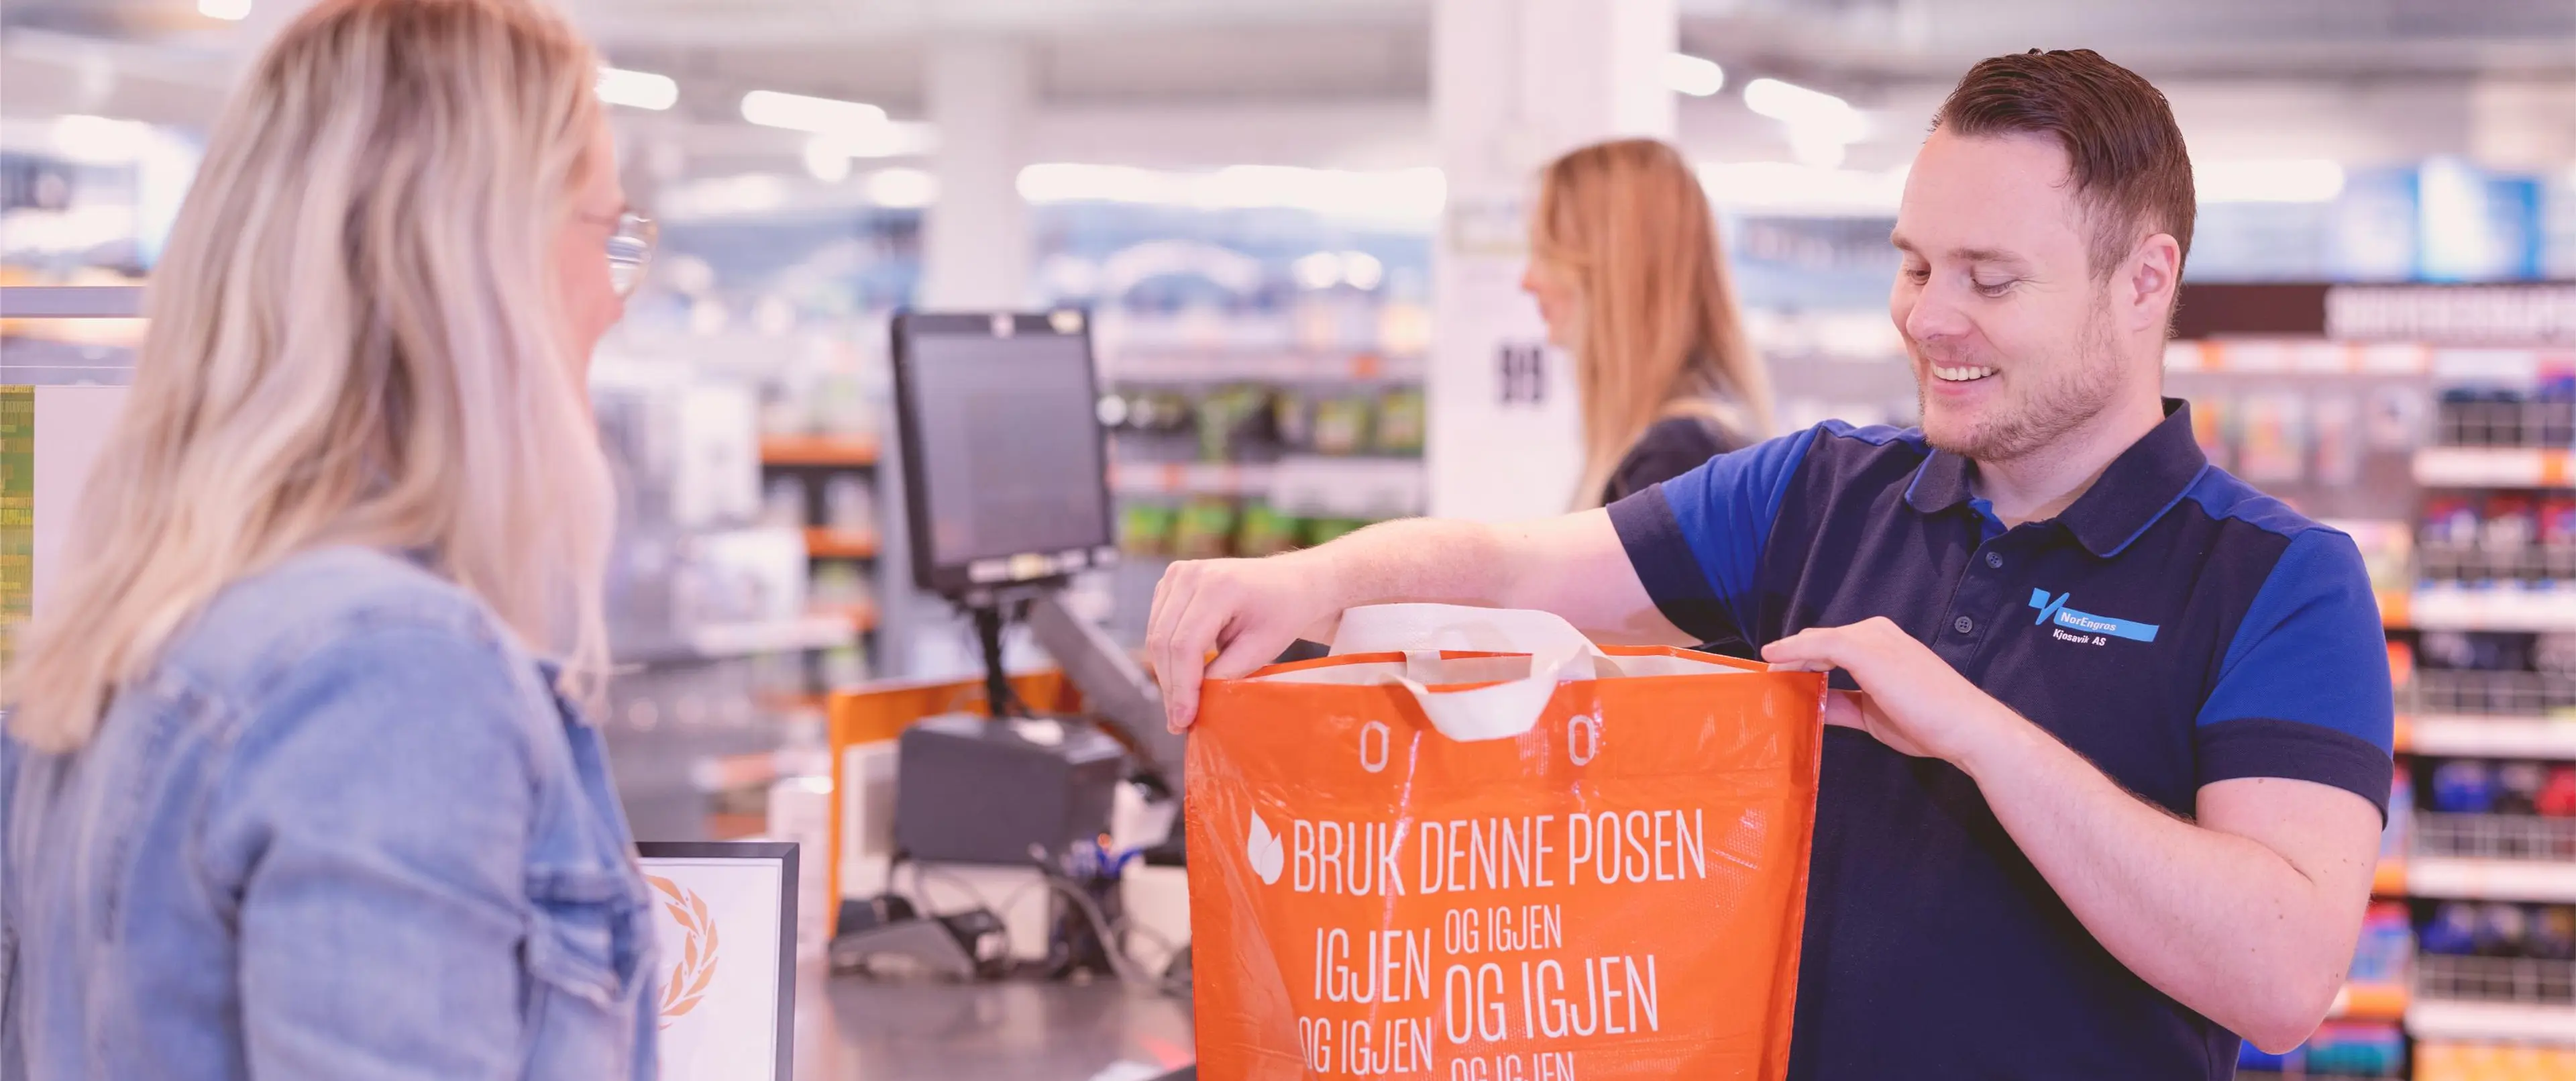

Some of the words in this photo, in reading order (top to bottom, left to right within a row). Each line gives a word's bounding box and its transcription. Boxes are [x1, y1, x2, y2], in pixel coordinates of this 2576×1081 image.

[2053, 628, 2089, 644] Kjosavik
[2092, 636, 2106, 646] AS
[2060, 611, 2116, 631] NorEngros
[1294, 819, 1405, 896] BRUK
[1421, 815, 1554, 894] DENNE
[1568, 809, 1706, 885] POSEN
[1444, 909, 1479, 955] OG
[1487, 904, 1562, 951] IGJEN
[1315, 927, 1431, 1004] IGJEN
[1444, 962, 1507, 1045] OG
[1521, 954, 1658, 1040] IGJEN
[1299, 1017, 1331, 1073] OG
[1341, 1017, 1433, 1076] IGJEN
